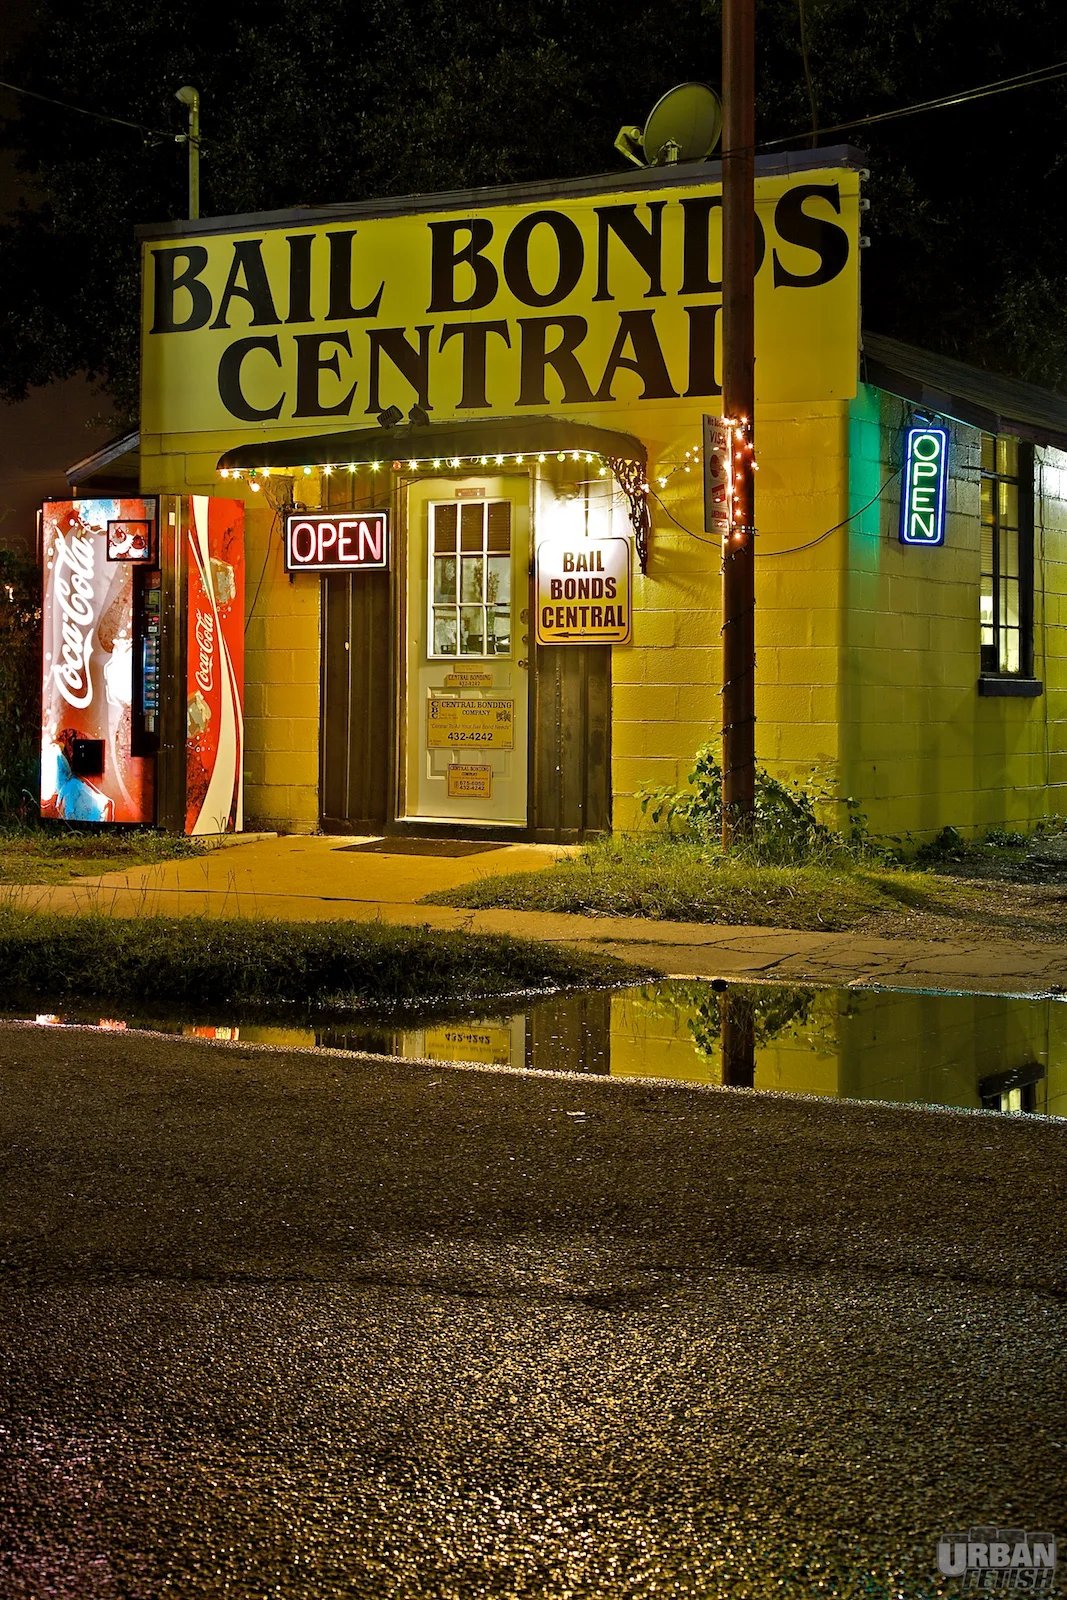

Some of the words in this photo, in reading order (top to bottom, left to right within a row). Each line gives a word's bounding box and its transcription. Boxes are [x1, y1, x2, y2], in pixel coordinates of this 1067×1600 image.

[149, 229, 386, 334] BAIL
[425, 183, 850, 315] BONDS
[910, 434, 940, 538] OPEN
[292, 520, 382, 563] OPEN
[562, 550, 605, 573] BAIL
[550, 577, 617, 601] BONDS
[53, 526, 95, 710] Coca-Cola
[541, 605, 626, 629] CENTRAL
[195, 608, 214, 692] Coca-Cola
[441, 701, 476, 709] CENTRAL
[477, 701, 512, 709] BONDING
[447, 732, 493, 742] 432-4242
